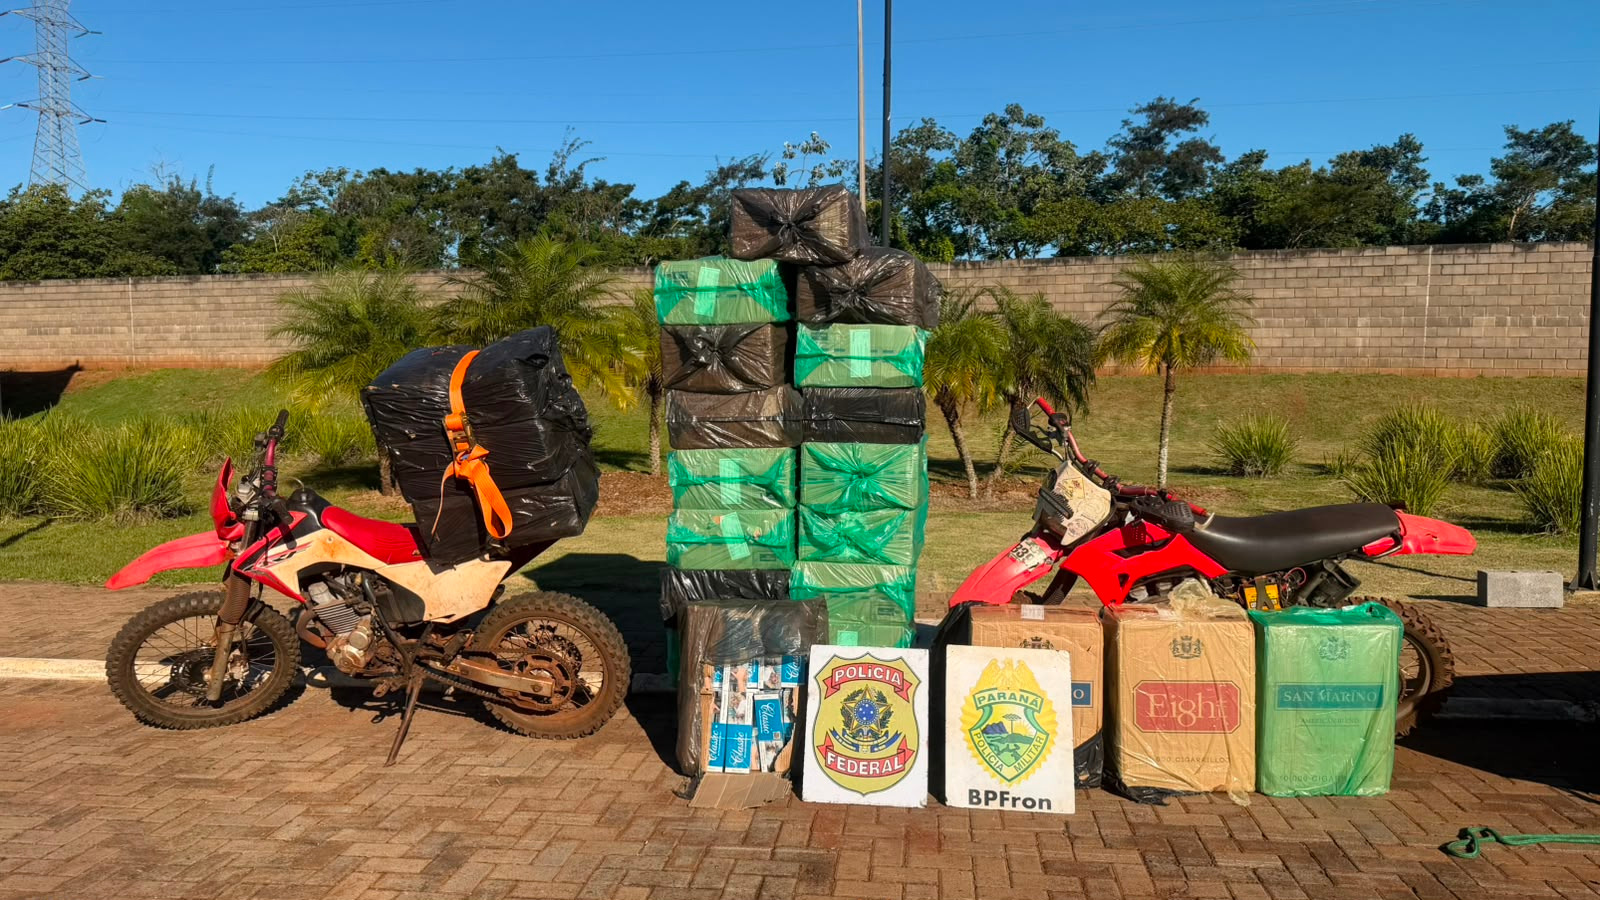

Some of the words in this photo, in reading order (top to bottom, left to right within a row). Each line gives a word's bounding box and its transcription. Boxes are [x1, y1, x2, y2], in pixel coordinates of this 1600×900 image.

[977, 692, 1039, 708] PARANÁ
[1283, 690, 1313, 702] SAN
[1319, 689, 1377, 702] MARINO
[761, 702, 776, 734] Classic
[728, 731, 746, 766] Classic
[1013, 735, 1045, 773] MILITAR
[827, 752, 904, 775] FEDERAL
[968, 788, 1052, 811] BPFron
